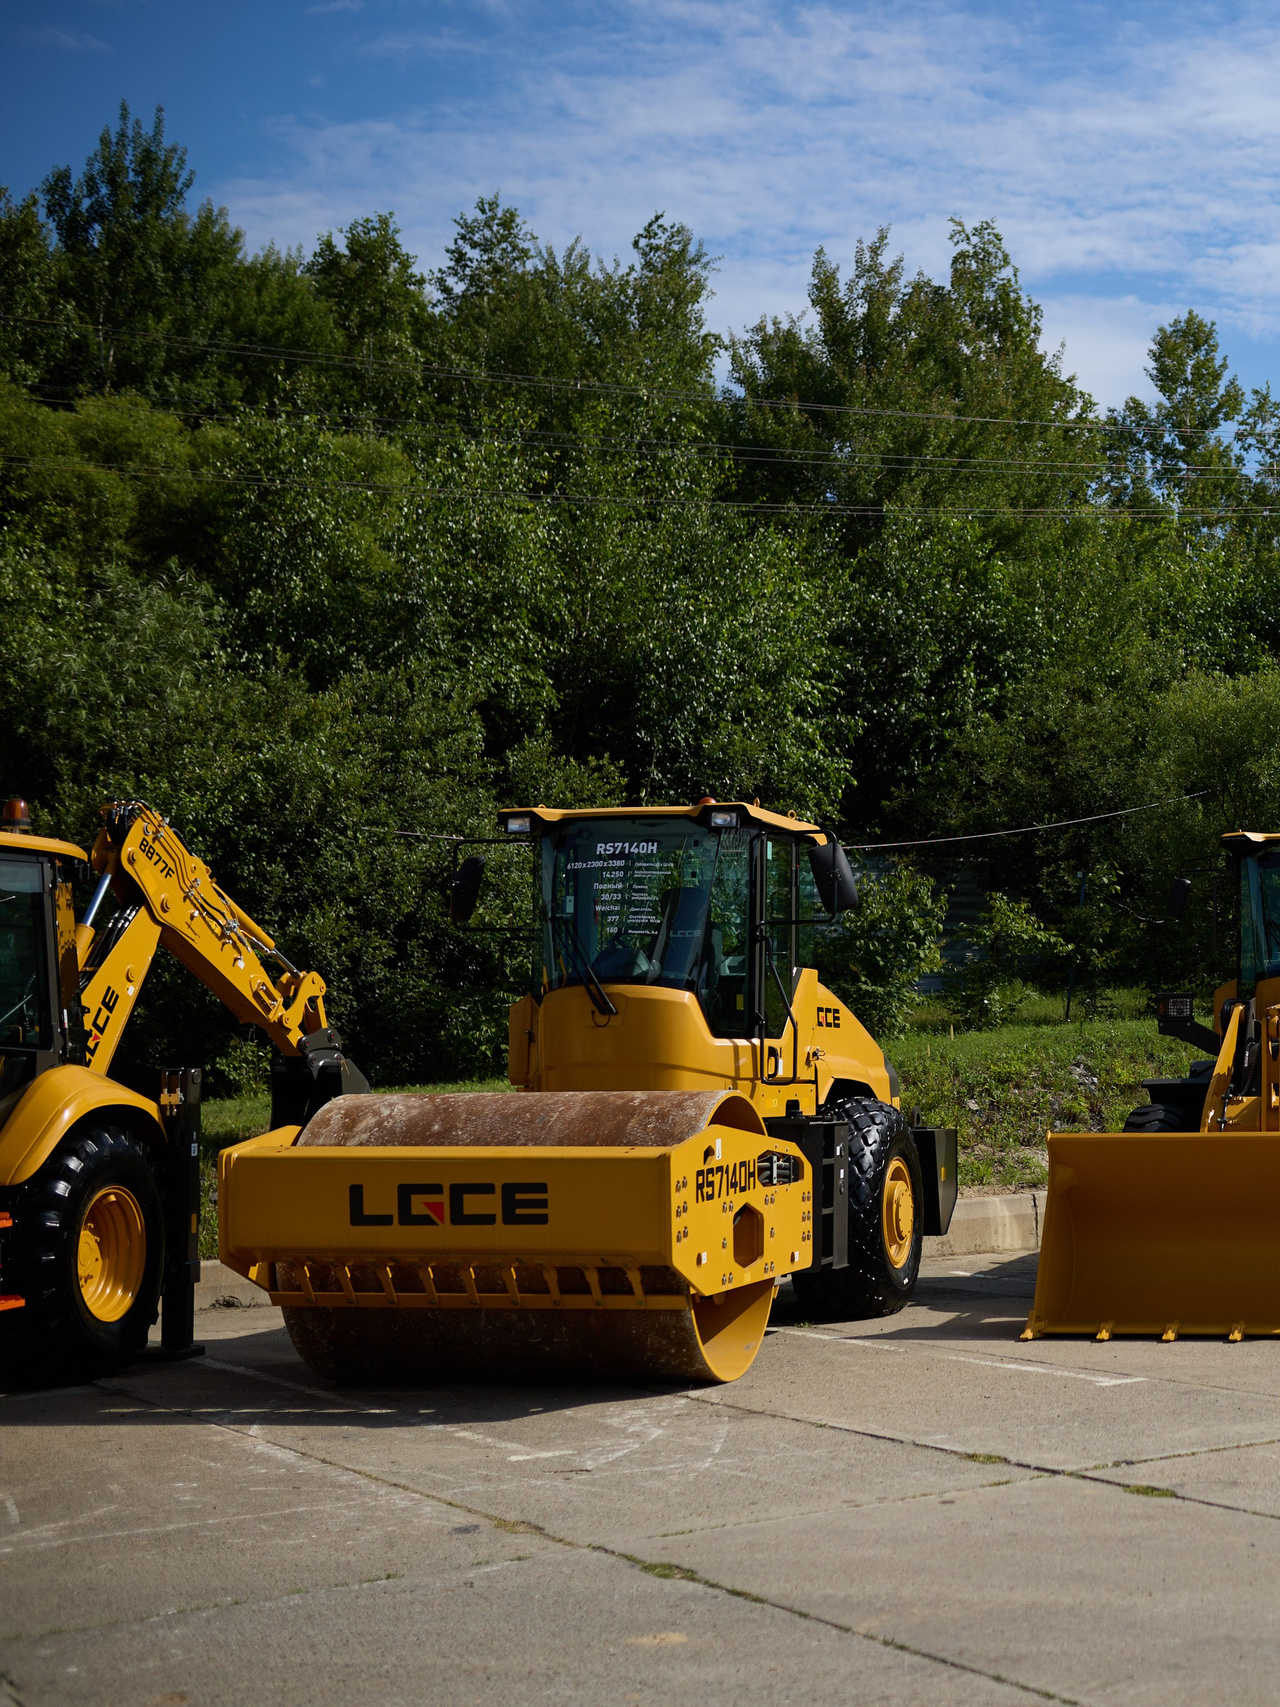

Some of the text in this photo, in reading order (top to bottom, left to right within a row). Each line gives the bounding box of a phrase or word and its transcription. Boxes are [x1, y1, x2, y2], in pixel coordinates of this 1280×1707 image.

[596, 842, 658, 854] RS7140H
[696, 1158, 756, 1204] RS7140H
[349, 1182, 549, 1226] LGCE
